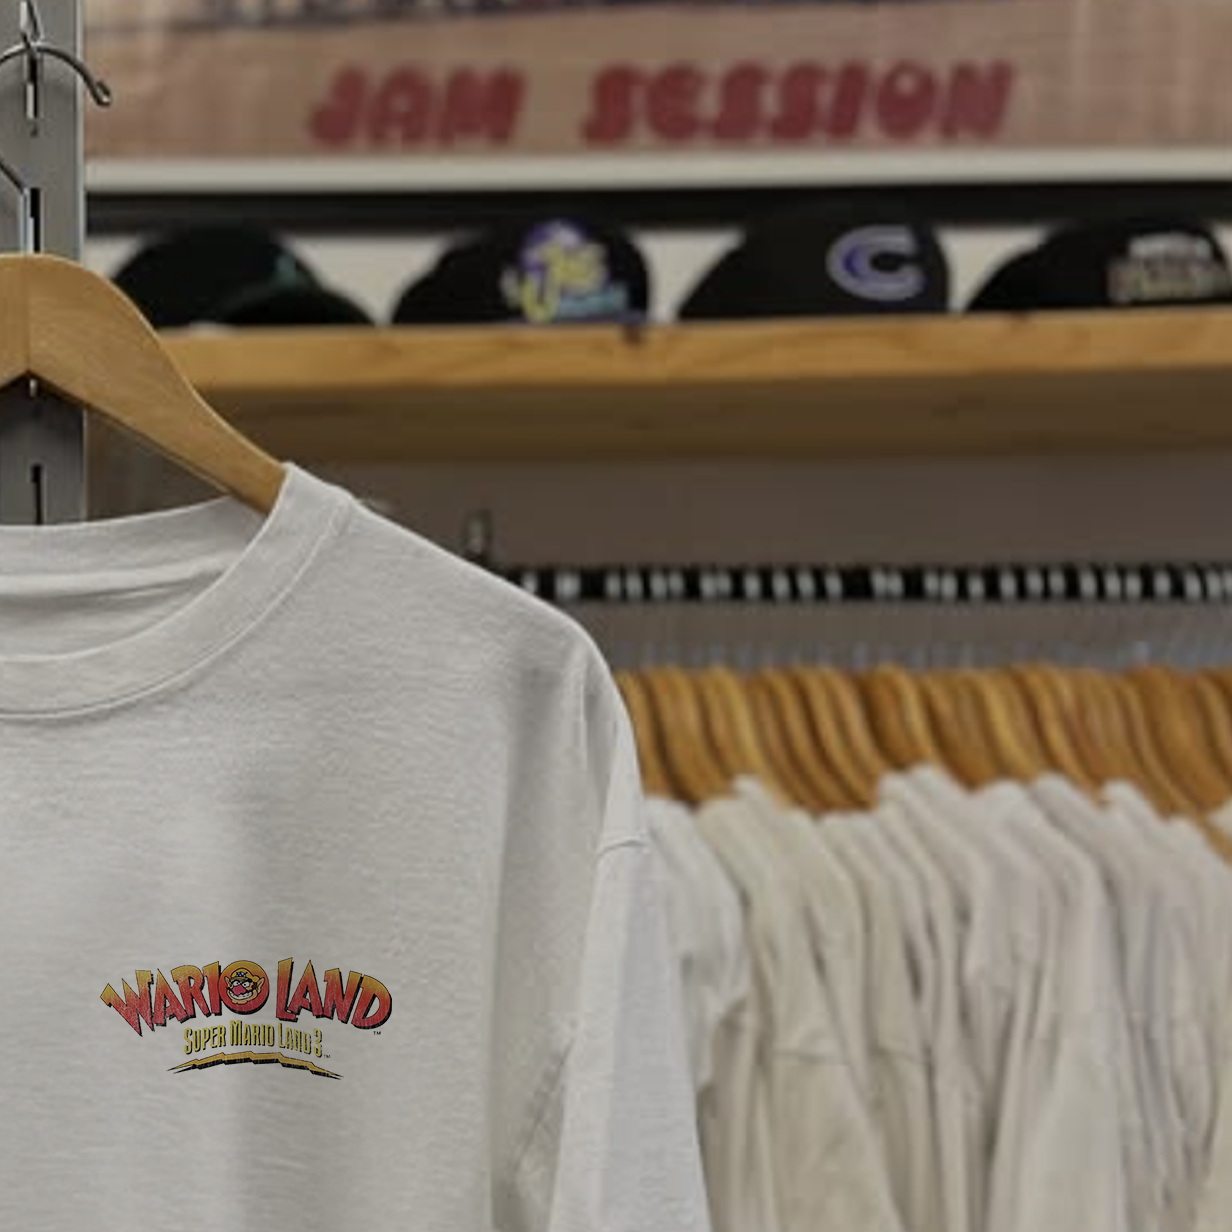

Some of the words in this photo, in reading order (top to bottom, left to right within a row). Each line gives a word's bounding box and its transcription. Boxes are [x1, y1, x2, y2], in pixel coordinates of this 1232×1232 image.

[308, 65, 525, 147] JAM
[581, 59, 1015, 146] SESSION
[100, 960, 269, 1037] WARIO
[276, 957, 392, 1030] LAND
[184, 1025, 226, 1054] SUPER
[230, 1020, 274, 1047] MARIO
[278, 1022, 311, 1054] LAND
[313, 1028, 322, 1058] 3
